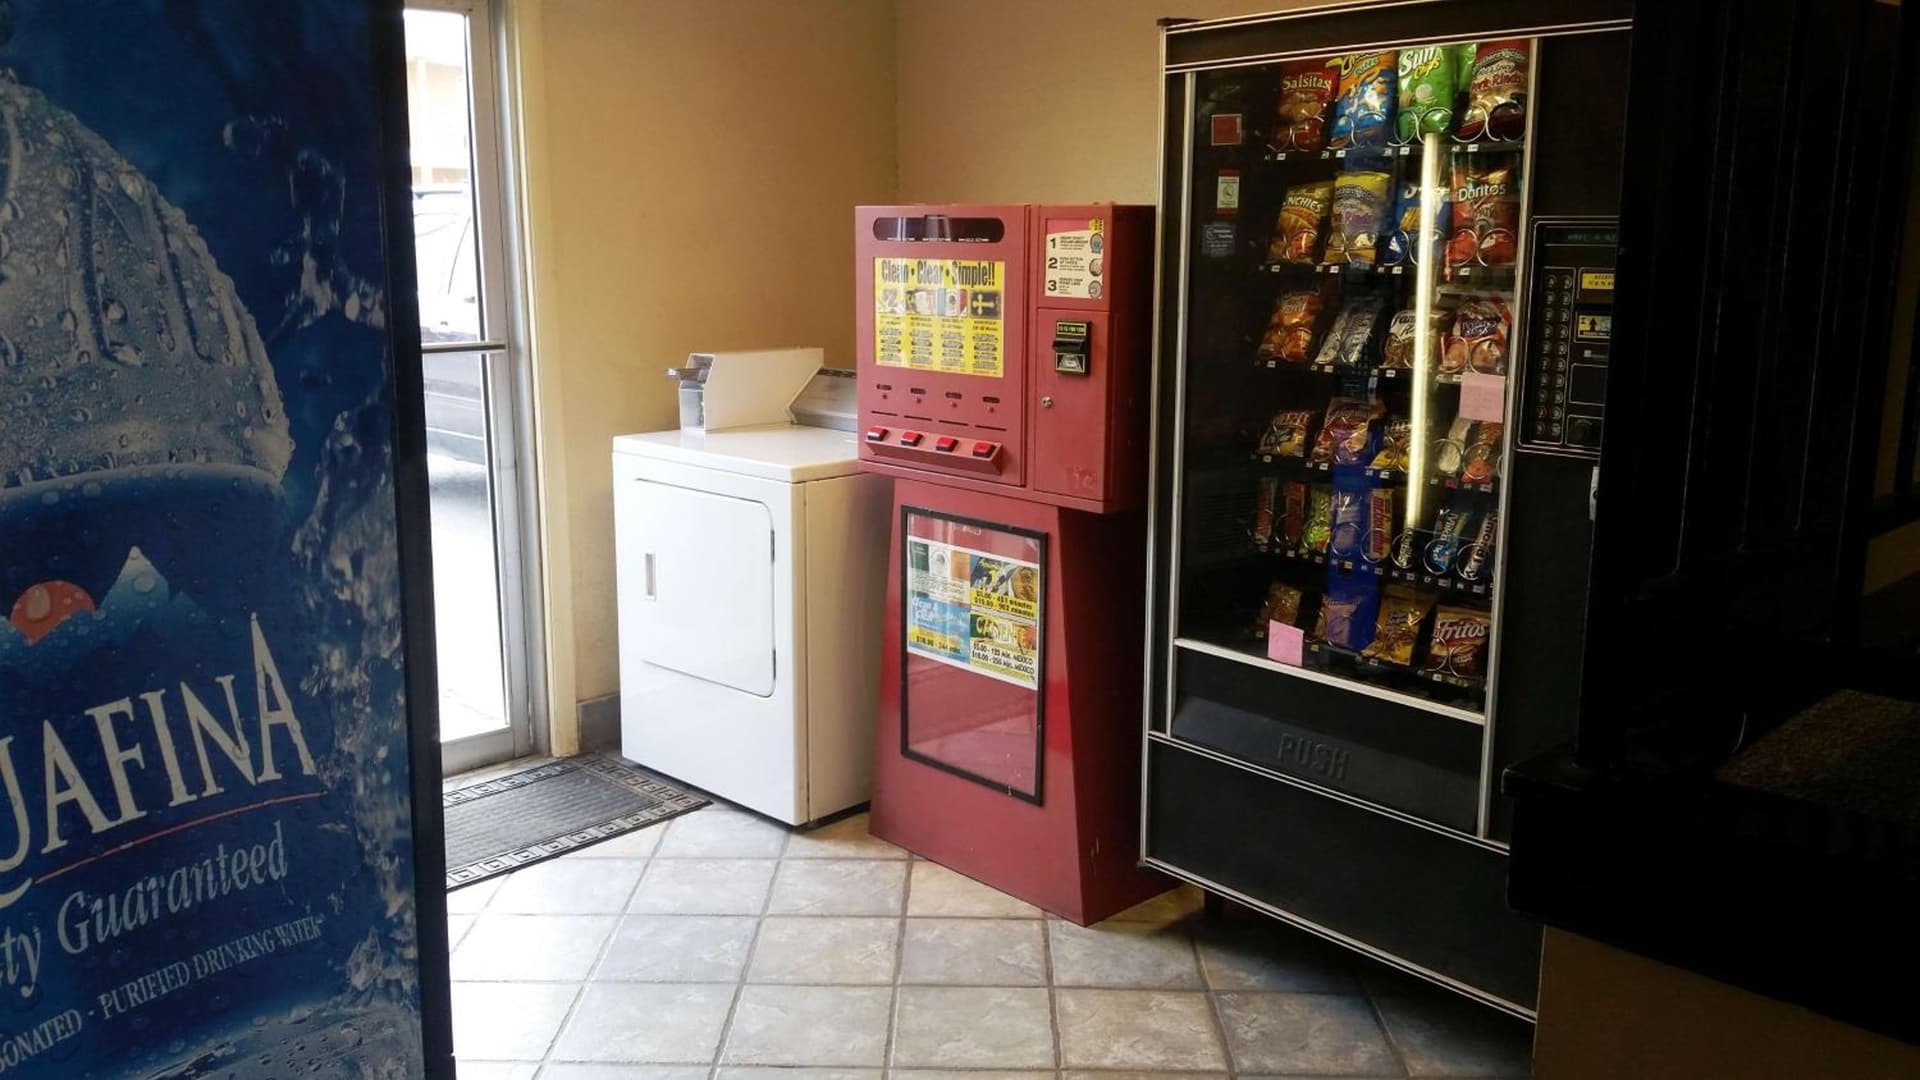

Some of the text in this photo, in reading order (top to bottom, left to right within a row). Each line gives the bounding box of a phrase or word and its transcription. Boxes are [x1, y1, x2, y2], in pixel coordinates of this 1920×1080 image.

[1398, 47, 1436, 78] Sun
[1282, 75, 1331, 90] Salsitas
[1459, 184, 1506, 201] Doritos
[1283, 196, 1322, 212] NCHIES
[1049, 238, 1057, 248] 1
[1048, 258, 1057, 269] 2
[882, 260, 995, 288] Clean Clear Simple!!
[1048, 280, 1057, 291] 3
[1440, 621, 1489, 641] Fritos
[1278, 732, 1351, 781] PUSH
[0, 818, 288, 998] ty Guaranteed
[98, 961, 191, 1020] PURIFIED
[191, 926, 276, 980] DRINKING
